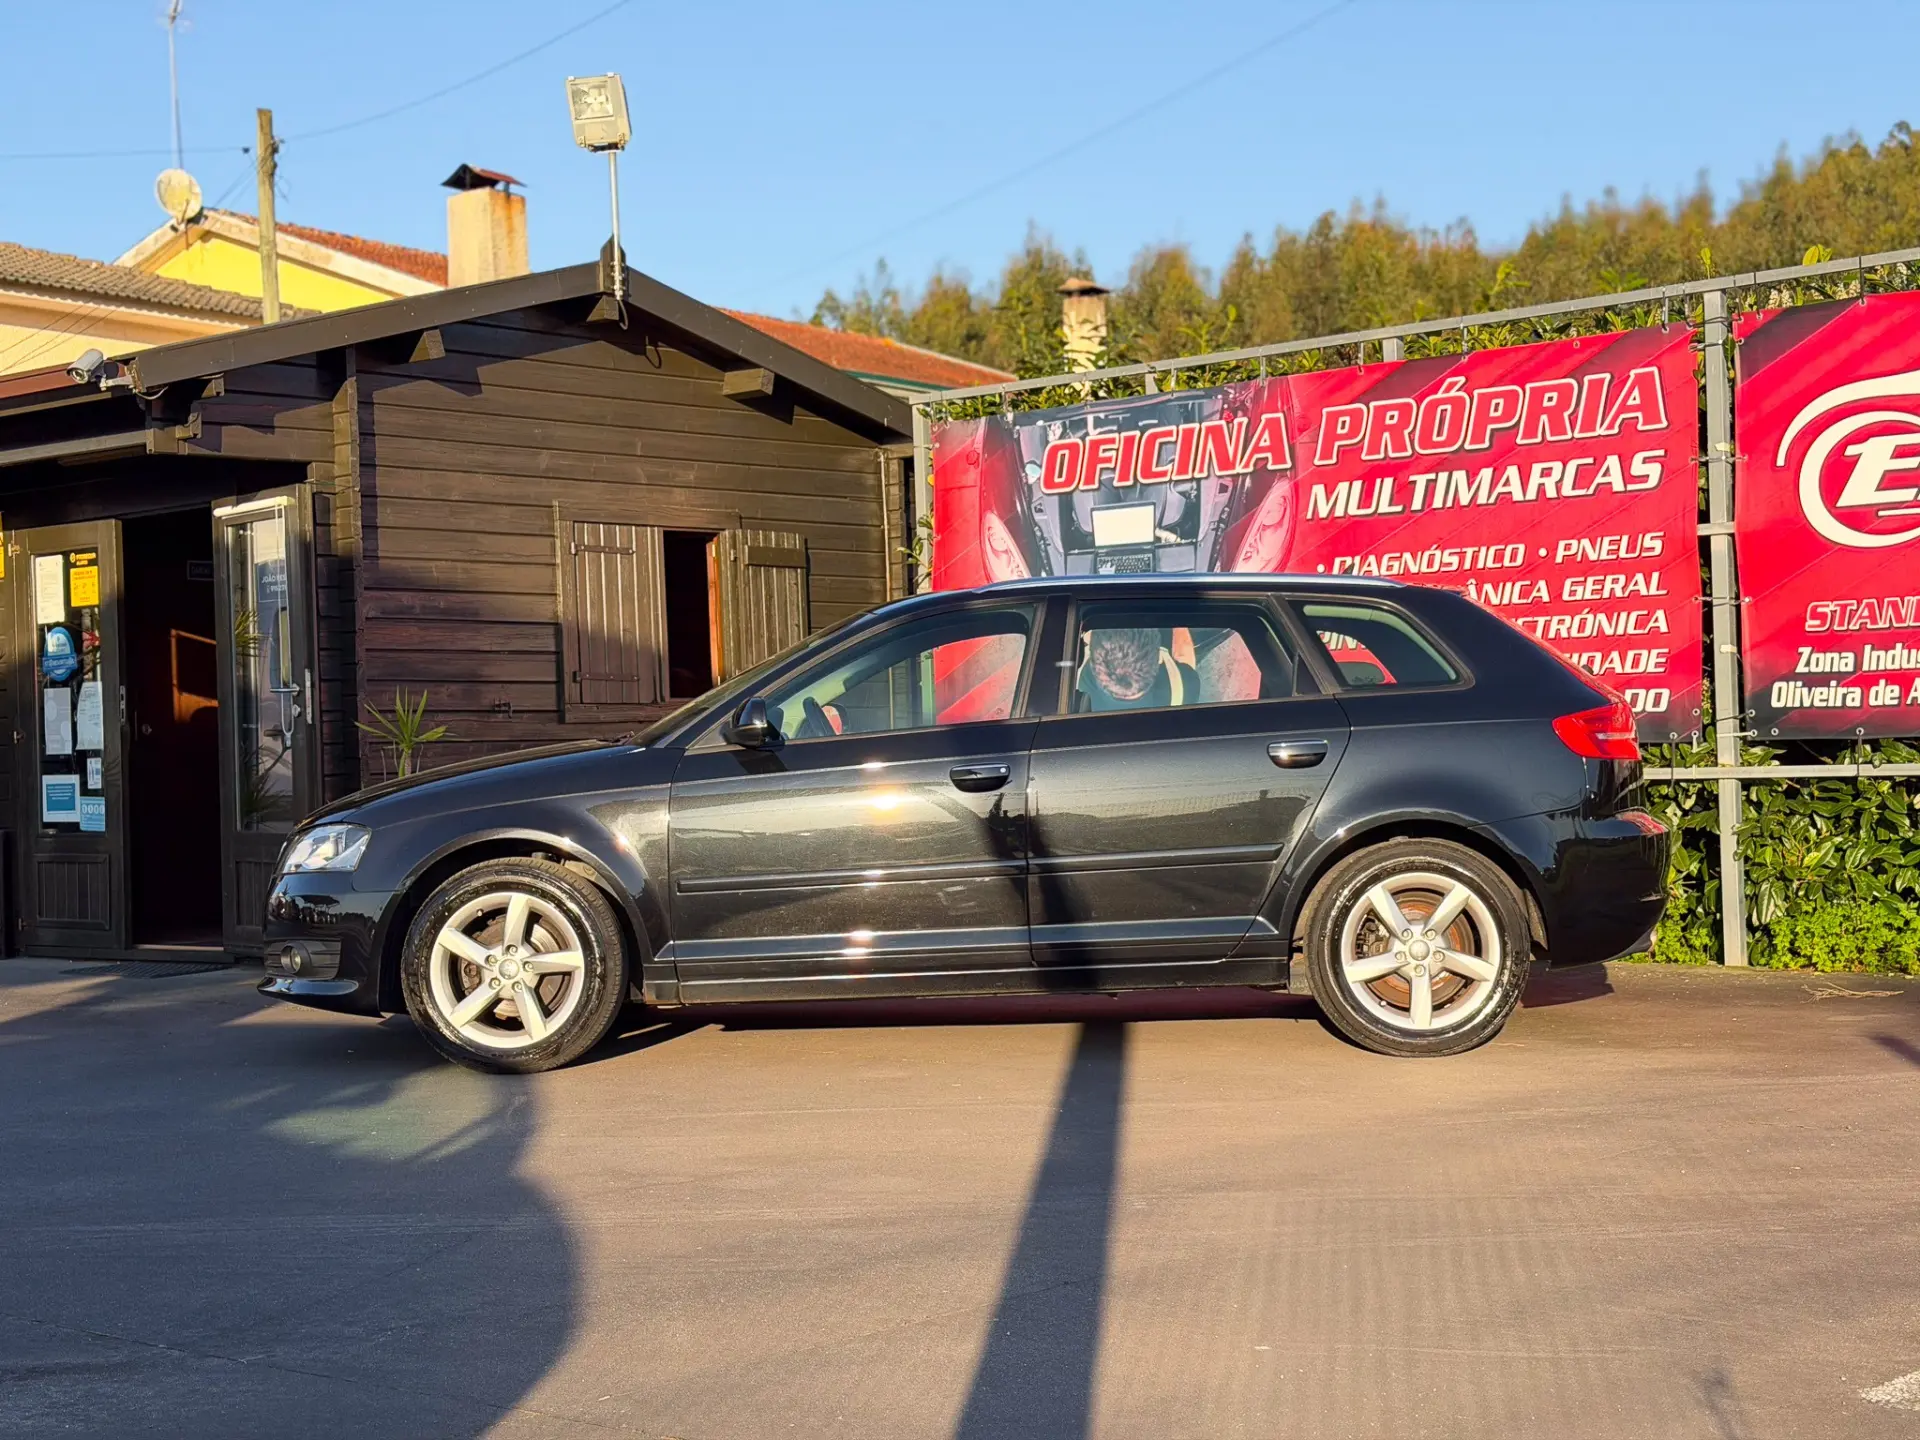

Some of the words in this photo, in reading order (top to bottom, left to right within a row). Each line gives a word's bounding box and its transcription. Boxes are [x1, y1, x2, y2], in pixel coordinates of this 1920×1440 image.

[1040, 412, 1292, 494] OFICINA
[1314, 366, 1669, 466] PRÓPRIA
[1306, 449, 1666, 520] MULTIMARCAS
[1835, 432, 1920, 507] E
[1332, 543, 1526, 577] DIAGNÓSTICO
[1555, 531, 1666, 564] PNEUS
[1466, 578, 1551, 606] ÂNICA
[1562, 572, 1669, 602] GERAL
[1511, 608, 1670, 640] TRÓNICA
[1563, 648, 1670, 676] IDADE
[1795, 647, 1855, 673] Zona
[1624, 688, 1671, 713] DO
[1770, 680, 1862, 708] Oliveira
[1868, 679, 1900, 706] de
